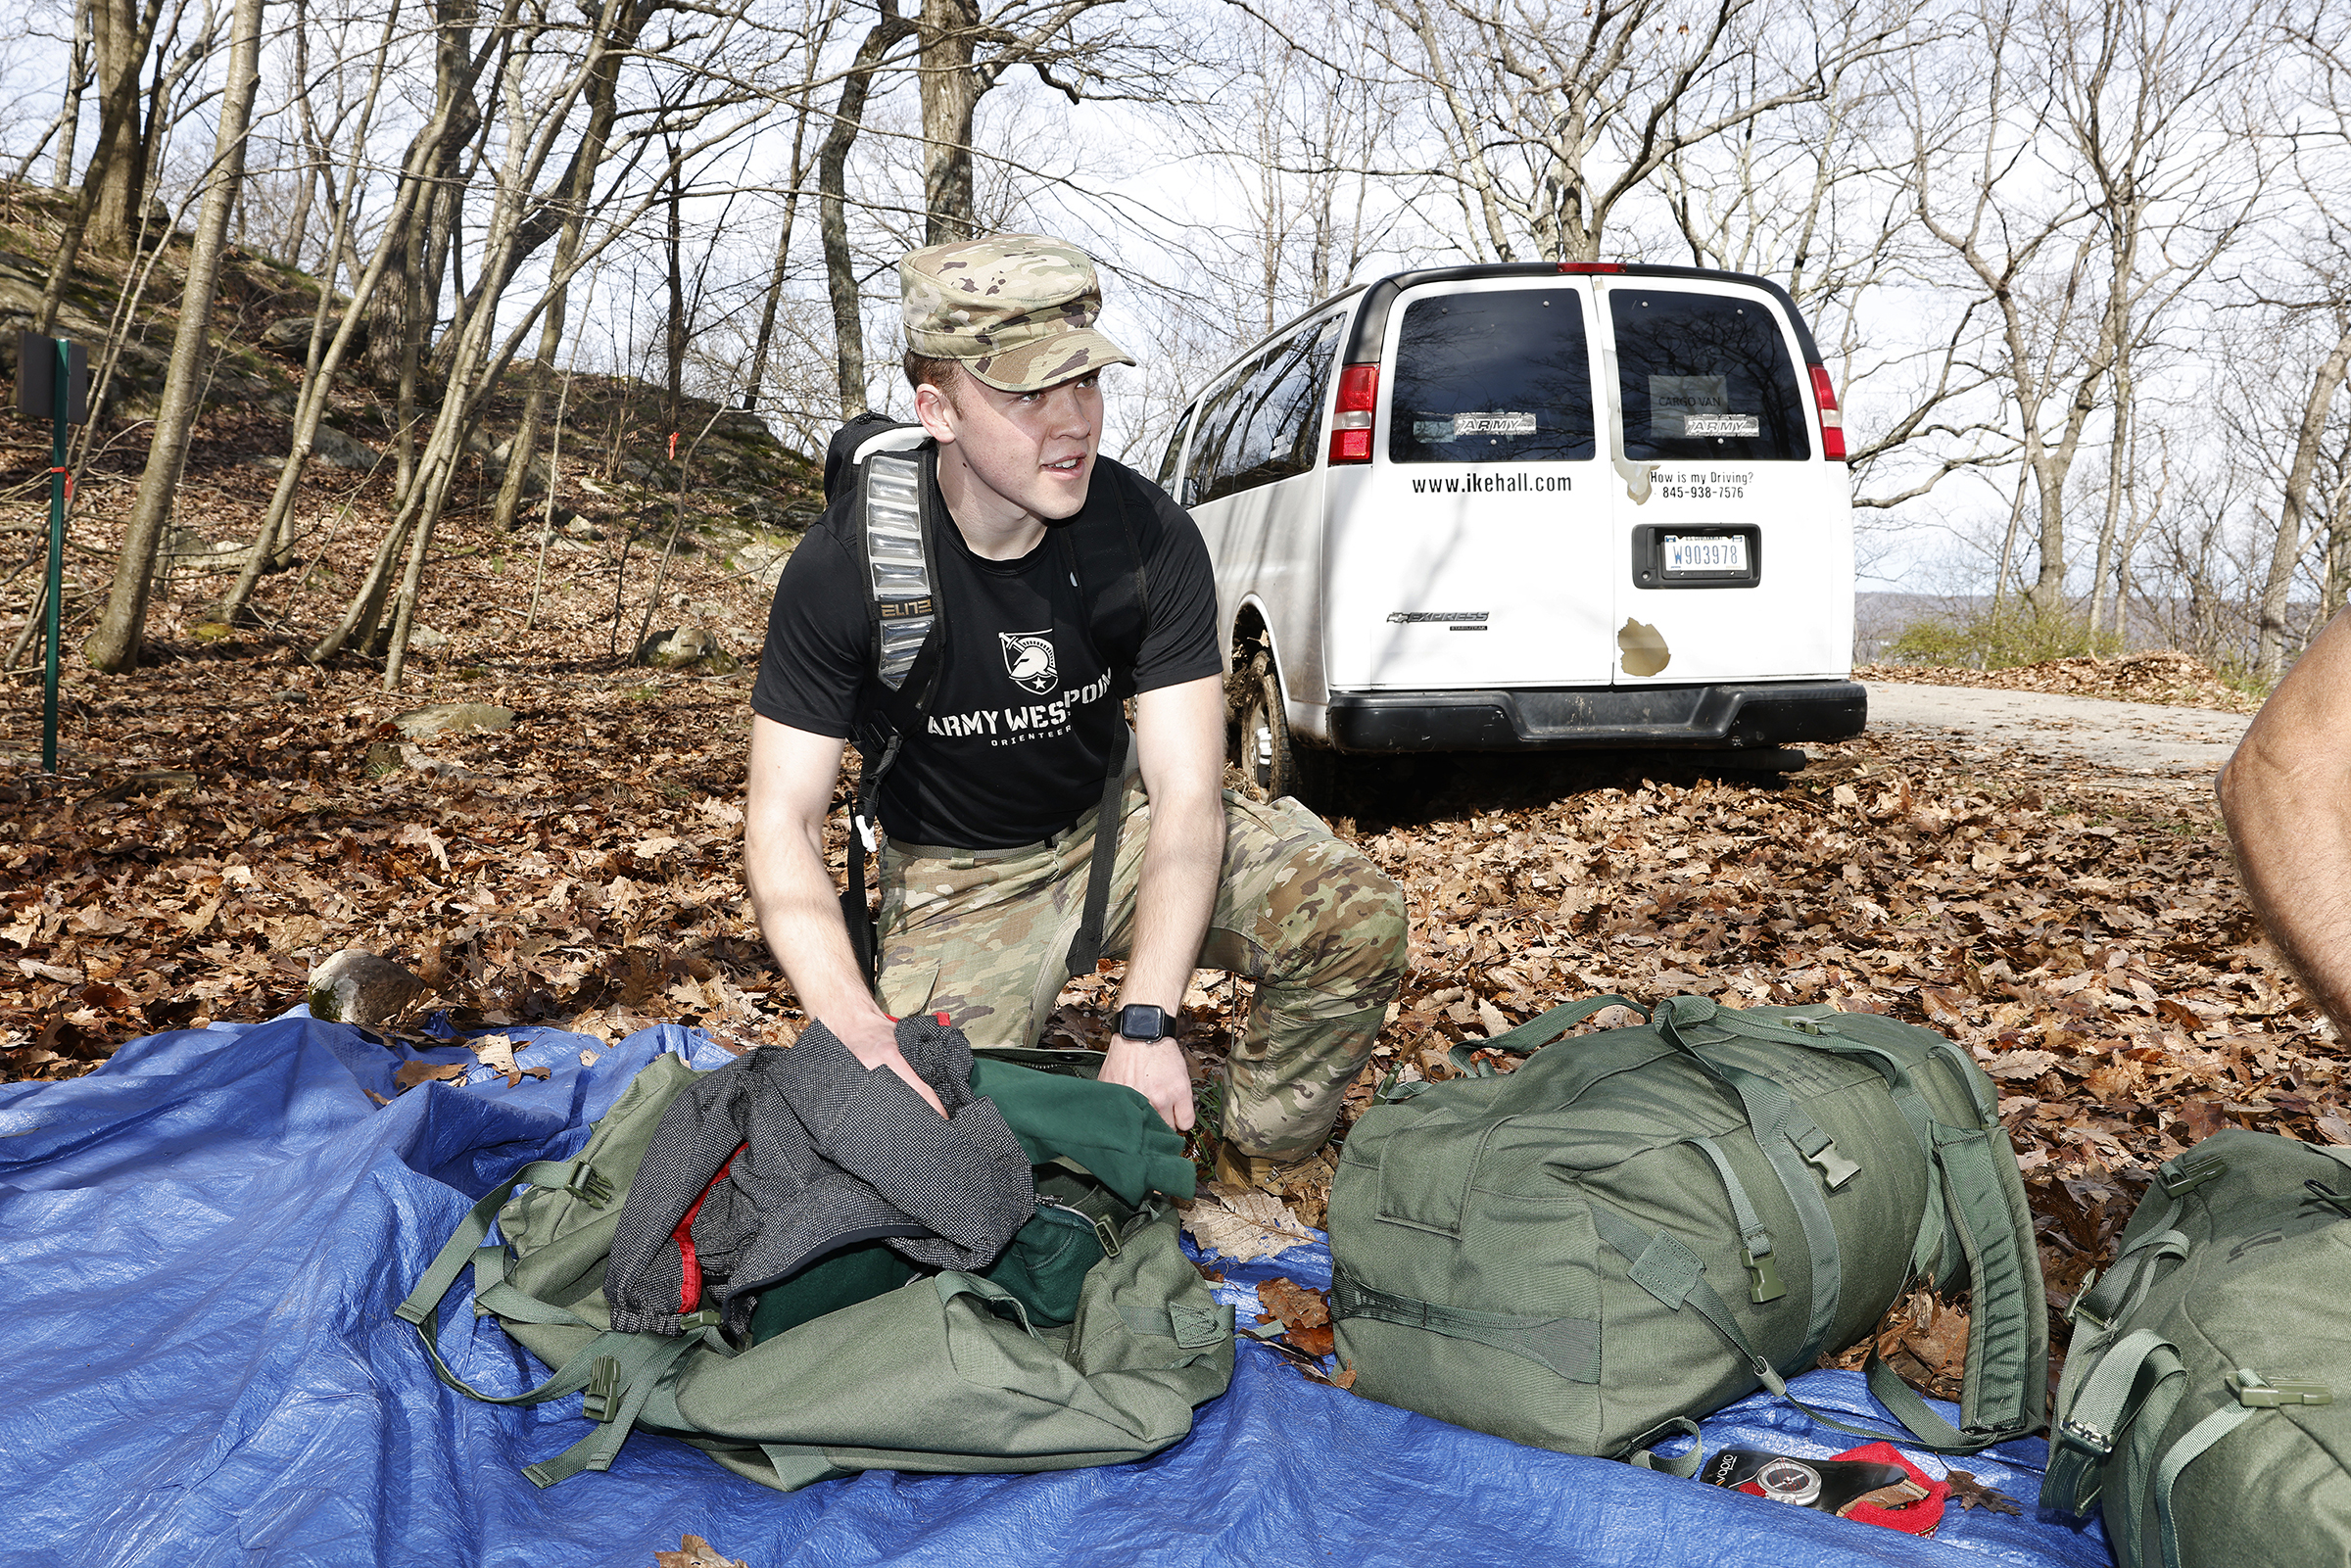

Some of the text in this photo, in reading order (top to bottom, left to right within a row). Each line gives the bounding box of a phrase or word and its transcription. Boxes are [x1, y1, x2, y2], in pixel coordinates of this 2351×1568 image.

[1658, 397, 1721, 407] CARGO VAN
[1462, 418, 1521, 432] ARMY
[1691, 419, 1747, 433] ARMY
[1413, 473, 1572, 493] www.ikehall.com
[1650, 471, 1753, 485] How is my Driving?
[1662, 486, 1744, 499] 845-938-7576
[1672, 545, 1738, 565] W903978
[882, 598, 932, 617] ELITE
[1409, 611, 1489, 622] EXPRESS
[928, 710, 999, 737] ARMY
[1004, 700, 1071, 732] WES
[990, 725, 1072, 746] ORIENTEER
